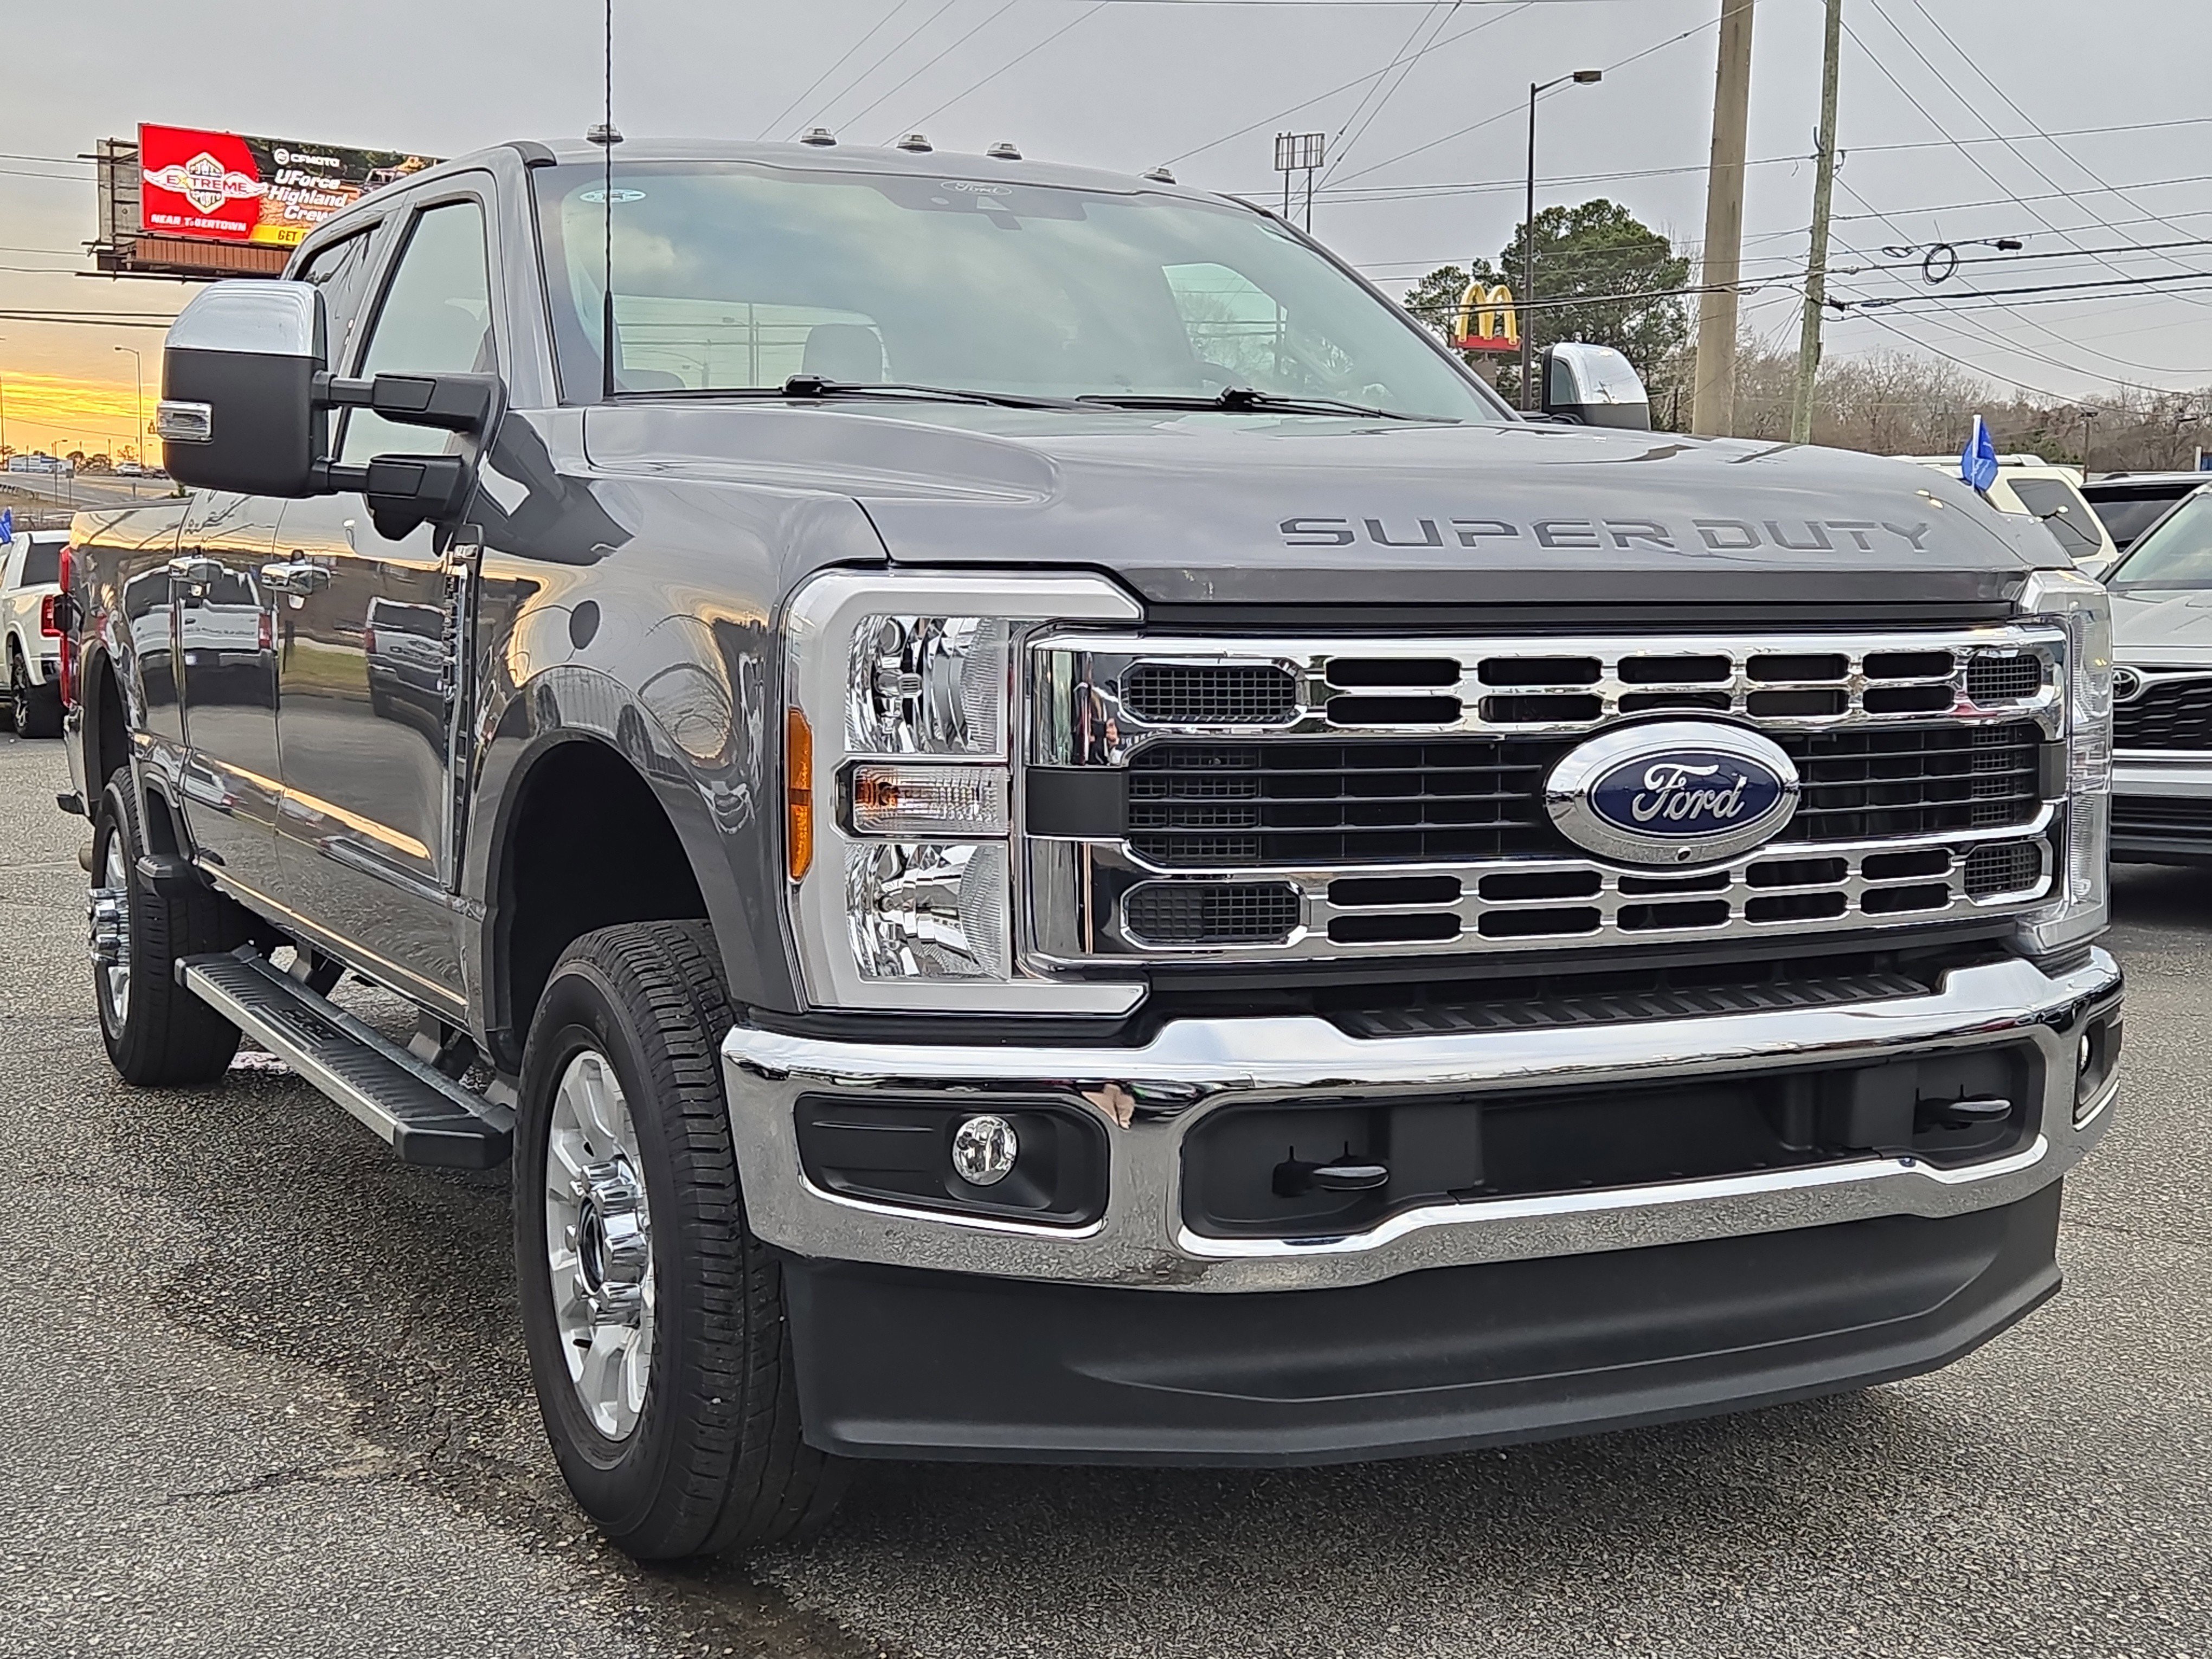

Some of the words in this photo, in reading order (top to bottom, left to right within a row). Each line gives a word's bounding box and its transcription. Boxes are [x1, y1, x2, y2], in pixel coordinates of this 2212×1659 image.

[166, 175, 247, 193] EXTREME
[274, 169, 340, 190] UForce
[955, 183, 998, 194] Ford
[268, 185, 349, 207] Highland
[151, 214, 181, 225] NEAR
[278, 230, 297, 242] GET
[1279, 517, 1680, 550] SUPER
[1692, 518, 1931, 552] DUTY
[1632, 763, 1748, 822] Ford
